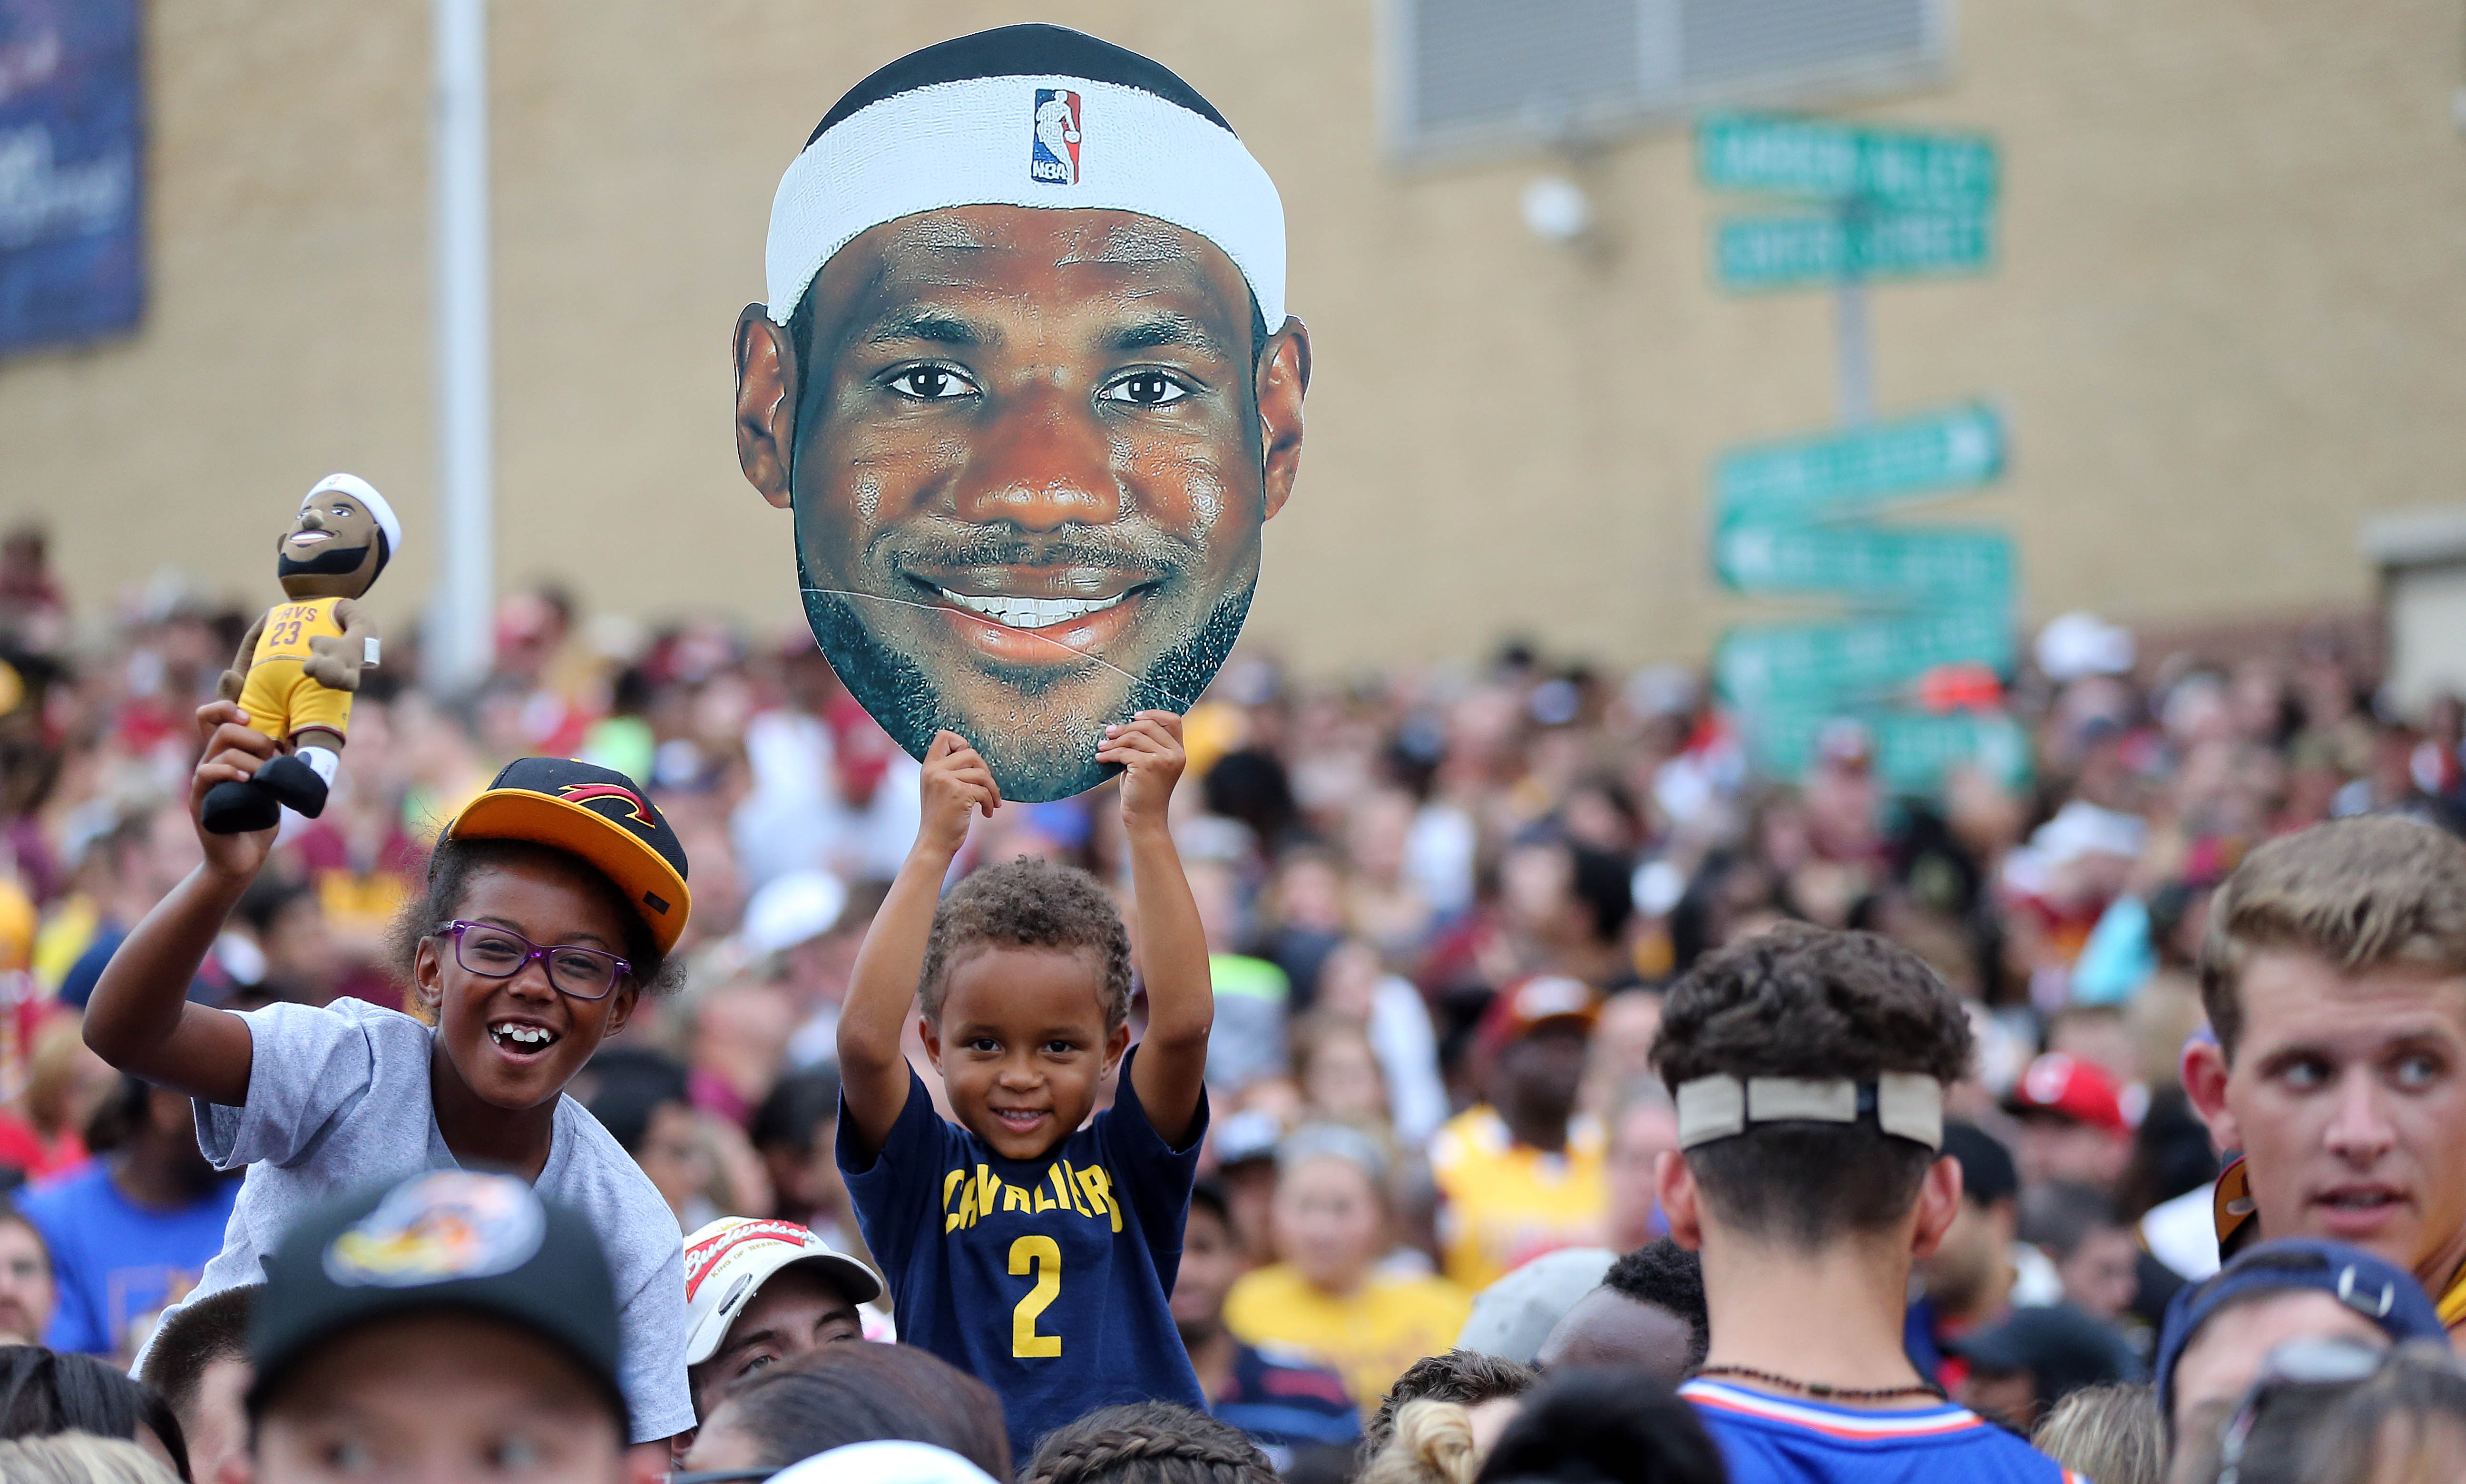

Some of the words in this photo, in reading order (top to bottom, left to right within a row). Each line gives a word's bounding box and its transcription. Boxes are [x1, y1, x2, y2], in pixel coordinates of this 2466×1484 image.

[1032, 160, 1068, 180] NBA
[270, 621, 302, 647] 23
[685, 1221, 815, 1281] Budweiser
[711, 1259, 732, 1278] KING
[734, 1250, 744, 1259] OF
[1008, 1235, 1062, 1358] 2
